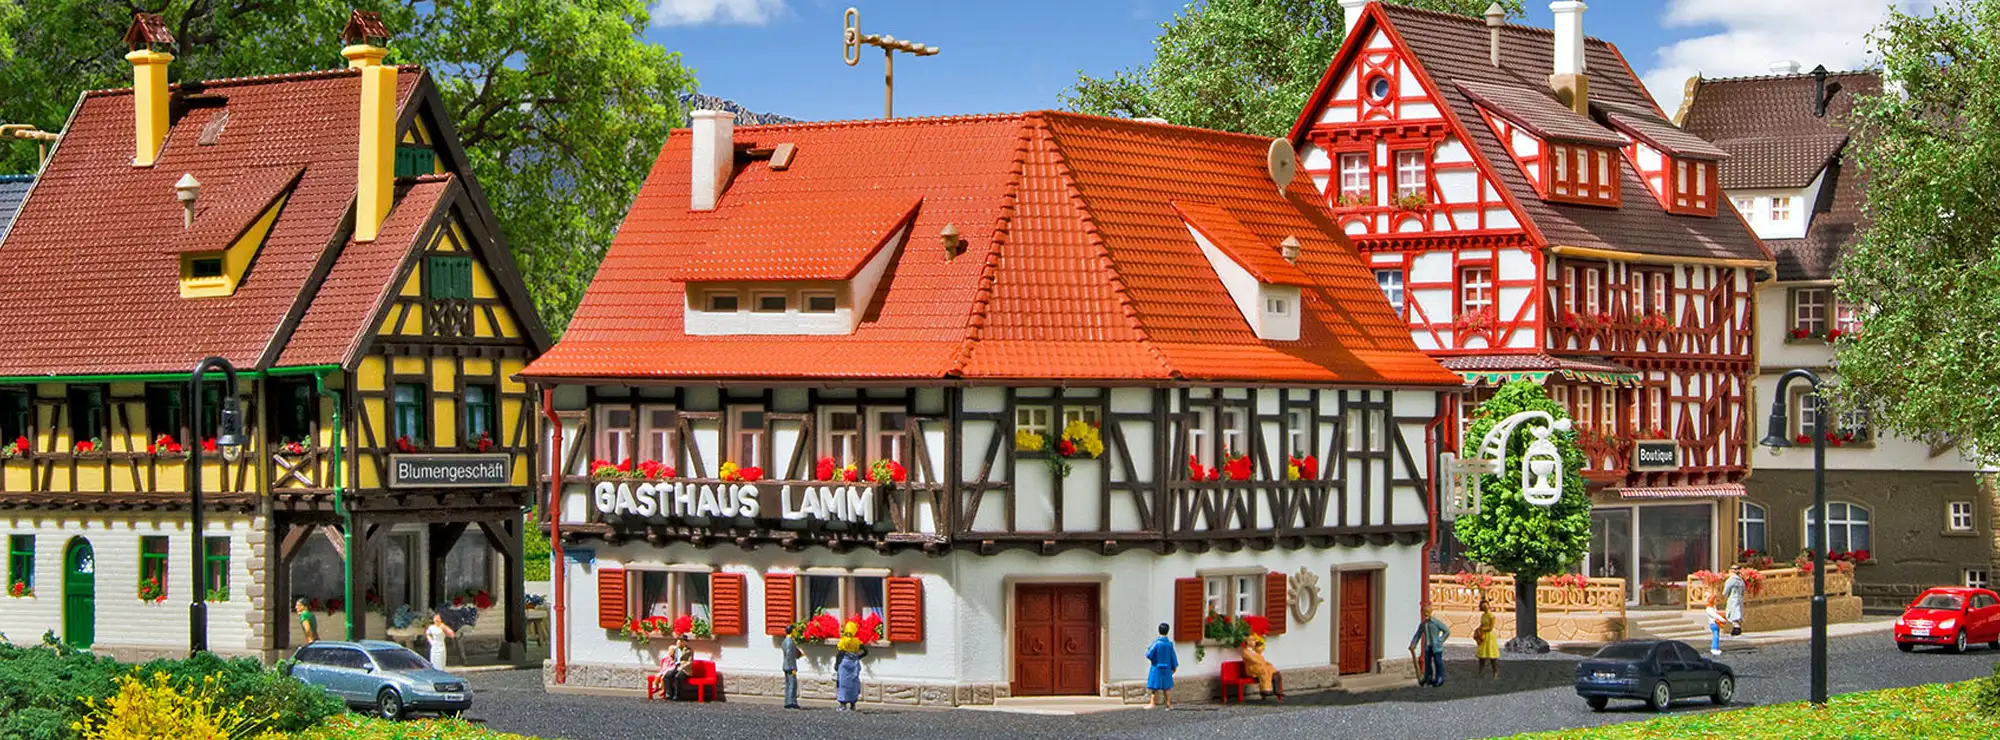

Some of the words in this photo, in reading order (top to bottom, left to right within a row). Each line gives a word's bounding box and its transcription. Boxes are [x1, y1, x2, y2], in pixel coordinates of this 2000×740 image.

[1640, 448, 1673, 463] Boutique
[399, 462, 504, 481] Blumengeschäft
[594, 481, 760, 518] GASTHAUS
[781, 484, 873, 525] LAMM
